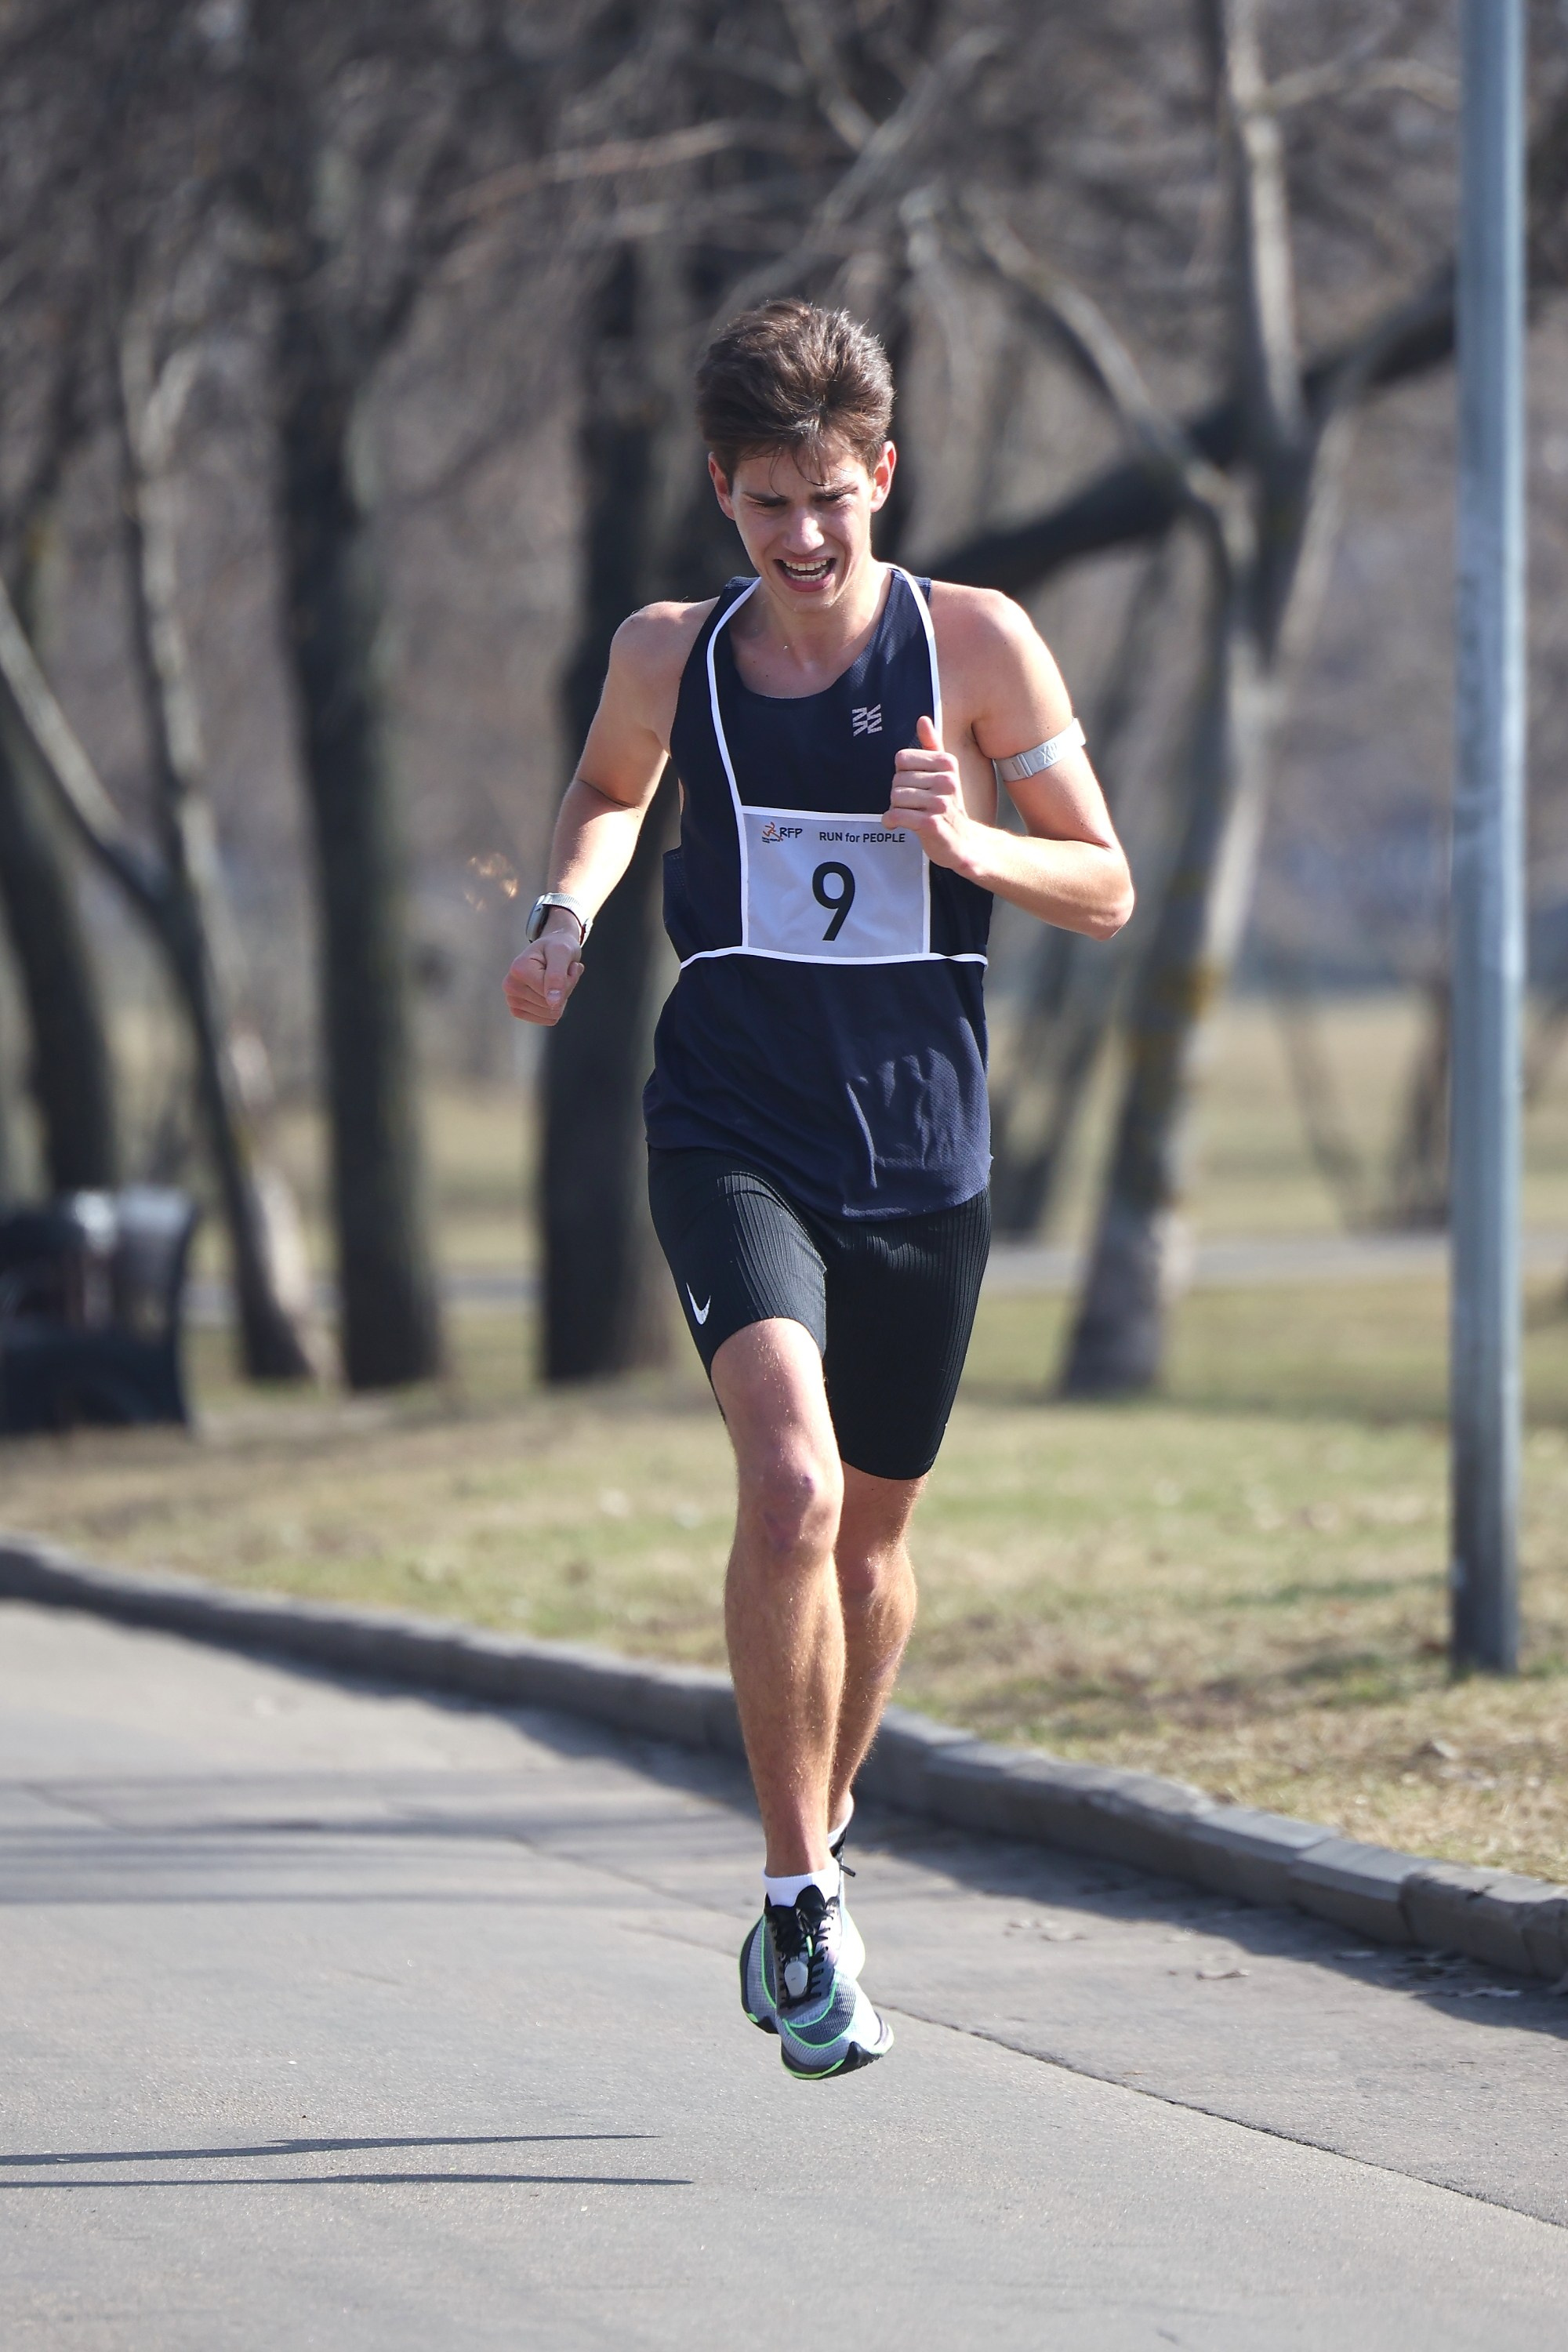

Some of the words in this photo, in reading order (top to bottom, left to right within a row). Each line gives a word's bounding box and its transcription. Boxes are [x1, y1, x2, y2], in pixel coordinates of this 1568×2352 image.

[779, 827, 803, 839] RFP
[819, 832, 842, 841] RUN
[845, 833, 860, 842] for
[862, 833, 906, 843] PEOPLE
[812, 861, 855, 941] 9
